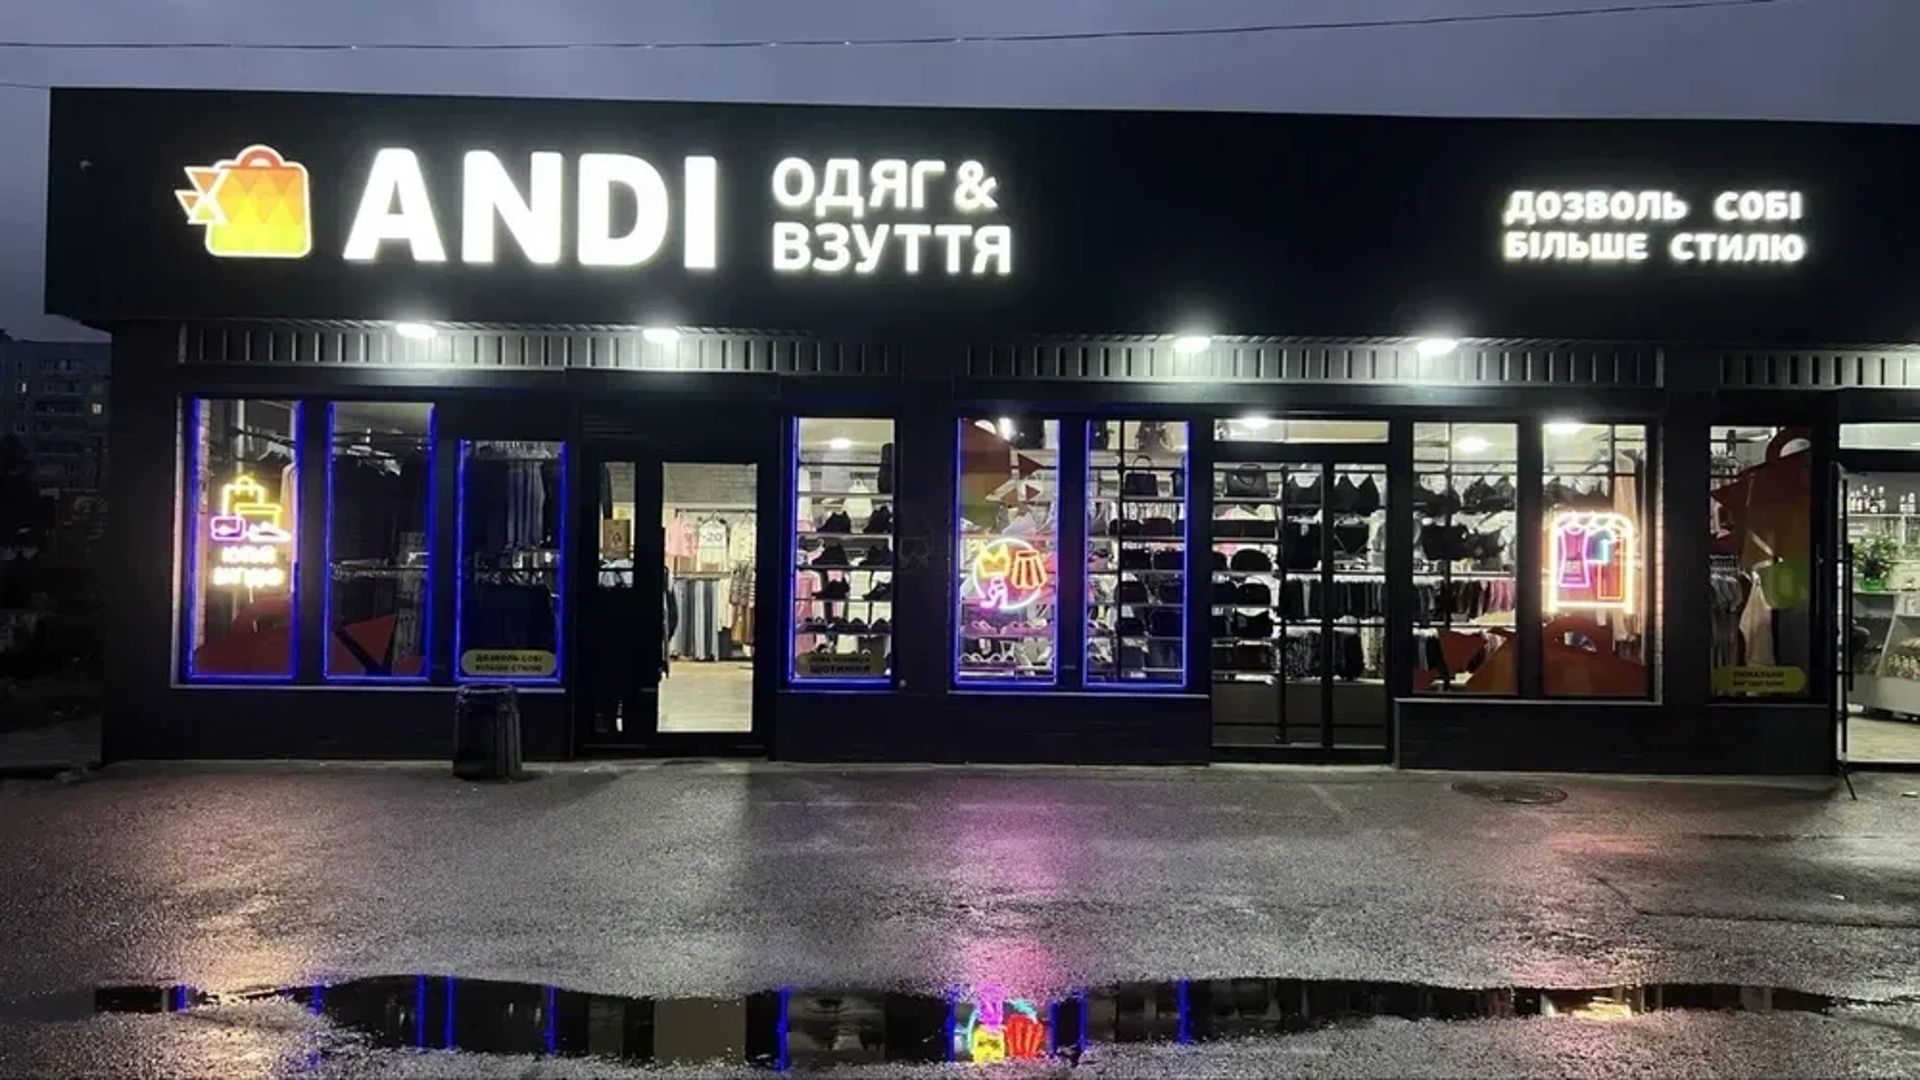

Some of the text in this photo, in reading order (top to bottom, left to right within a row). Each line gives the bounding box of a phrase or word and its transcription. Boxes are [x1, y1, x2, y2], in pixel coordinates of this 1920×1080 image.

[343, 148, 717, 270] ANDI
[772, 157, 946, 217] ОДЯГ
[1503, 190, 1802, 226] ДОЗВОЛЬ СОБІ
[772, 222, 1011, 274] ВЗУТТЯ
[1504, 231, 1806, 262] БІЛЬШЕ СТИЛЮ
